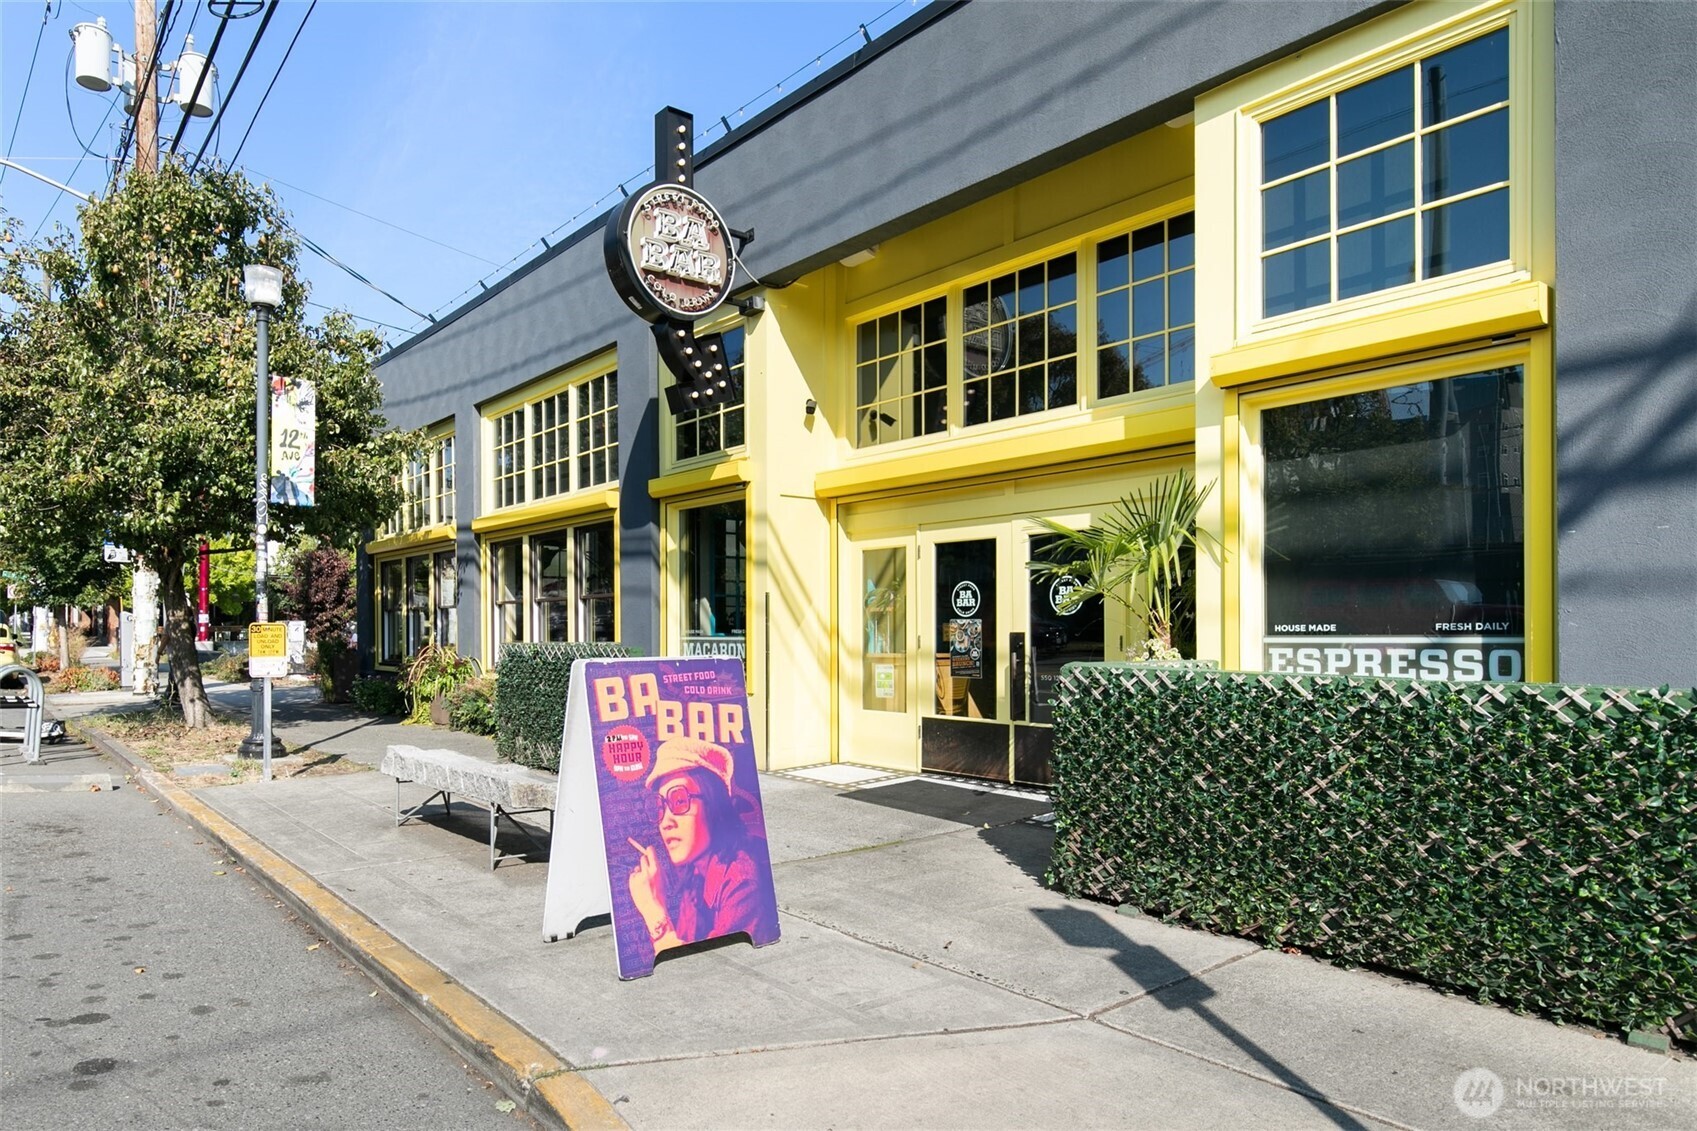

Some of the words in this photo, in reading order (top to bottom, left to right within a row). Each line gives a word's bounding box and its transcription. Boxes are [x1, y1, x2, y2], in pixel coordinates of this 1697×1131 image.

[642, 192, 685, 212] STREET
[688, 198, 719, 228] FOOD
[654, 207, 710, 252] BA
[640, 236, 722, 286] BAR
[648, 275, 676, 301] COLD
[959, 590, 973, 599] BA
[956, 598, 976, 607] BAR
[251, 625, 261, 633] 30
[1275, 624, 1306, 632] HOUSE
[1308, 623, 1337, 632] MADE
[1435, 622, 1472, 631] FRESH
[1475, 621, 1510, 631] DAILY
[1268, 647, 1522, 682] ESPRESSO
[663, 672, 693, 683] STREET
[694, 671, 716, 681] FOOD
[684, 685, 706, 695] COLD
[707, 686, 732, 695] DRINK
[593, 673, 661, 723] BA
[655, 700, 745, 744] BAR
[608, 741, 643, 753] HAPPY
[613, 752, 642, 764] HOUR
